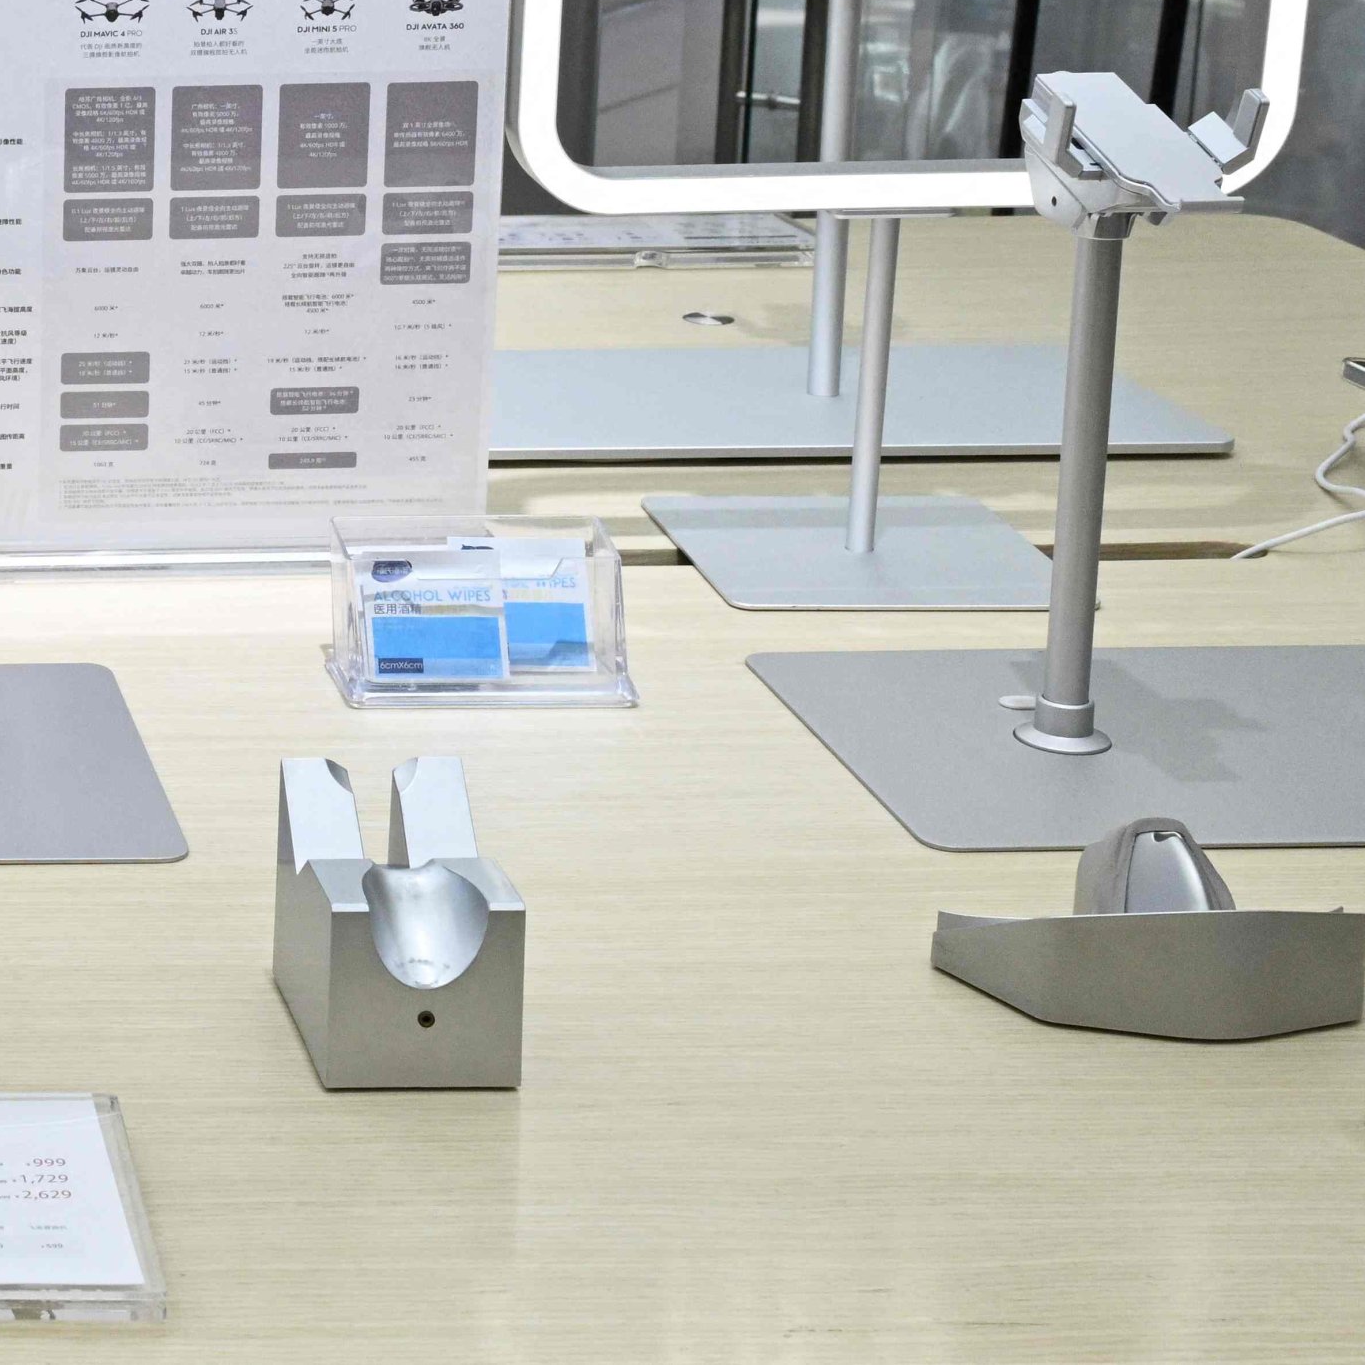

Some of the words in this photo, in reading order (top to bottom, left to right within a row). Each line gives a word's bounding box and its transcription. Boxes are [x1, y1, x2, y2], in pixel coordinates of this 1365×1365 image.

[228, 27, 238, 35] 3S
[406, 23, 419, 31] DJI
[449, 22, 464, 30] 360
[373, 589, 443, 601] ALCOHOL
[448, 589, 491, 601] WIPES
